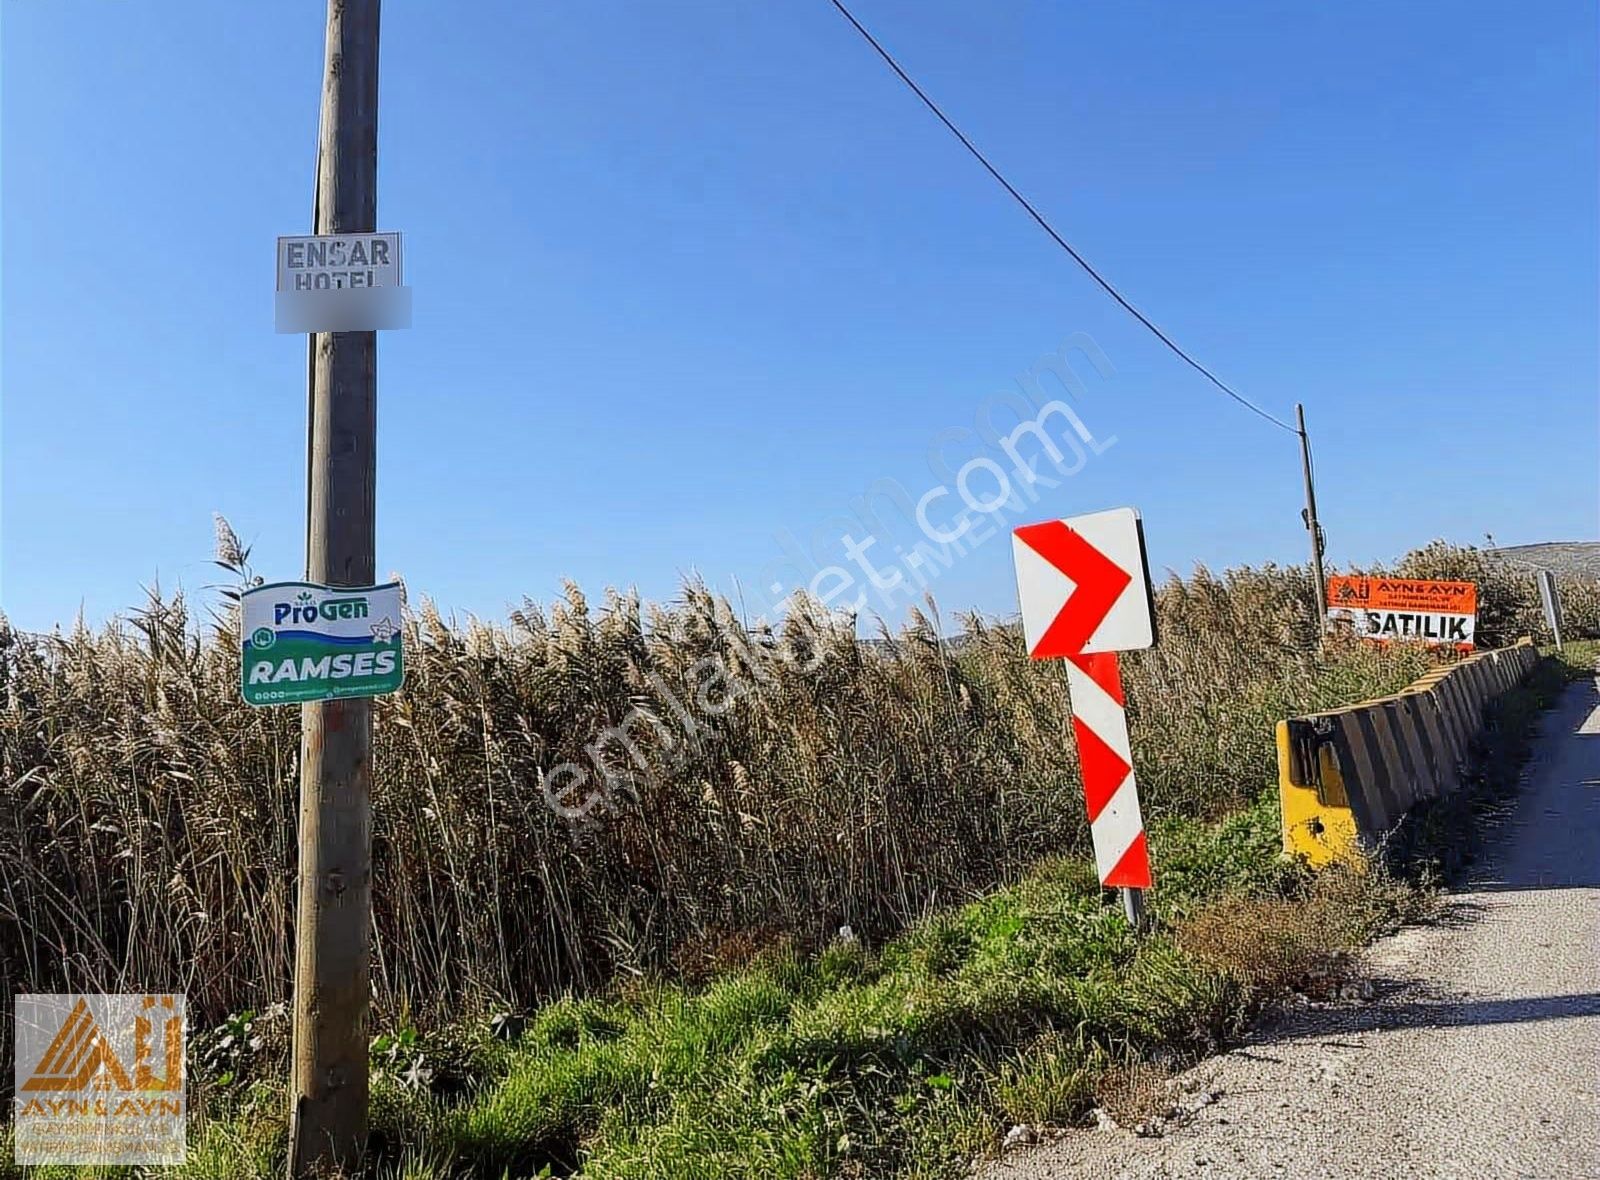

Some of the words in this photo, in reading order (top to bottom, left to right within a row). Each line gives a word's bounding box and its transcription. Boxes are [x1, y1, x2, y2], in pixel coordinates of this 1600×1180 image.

[287, 240, 390, 268] ENSAR
[274, 597, 369, 625] ProGen
[1367, 612, 1468, 640] SATILIK
[249, 650, 396, 684] RAMSES
